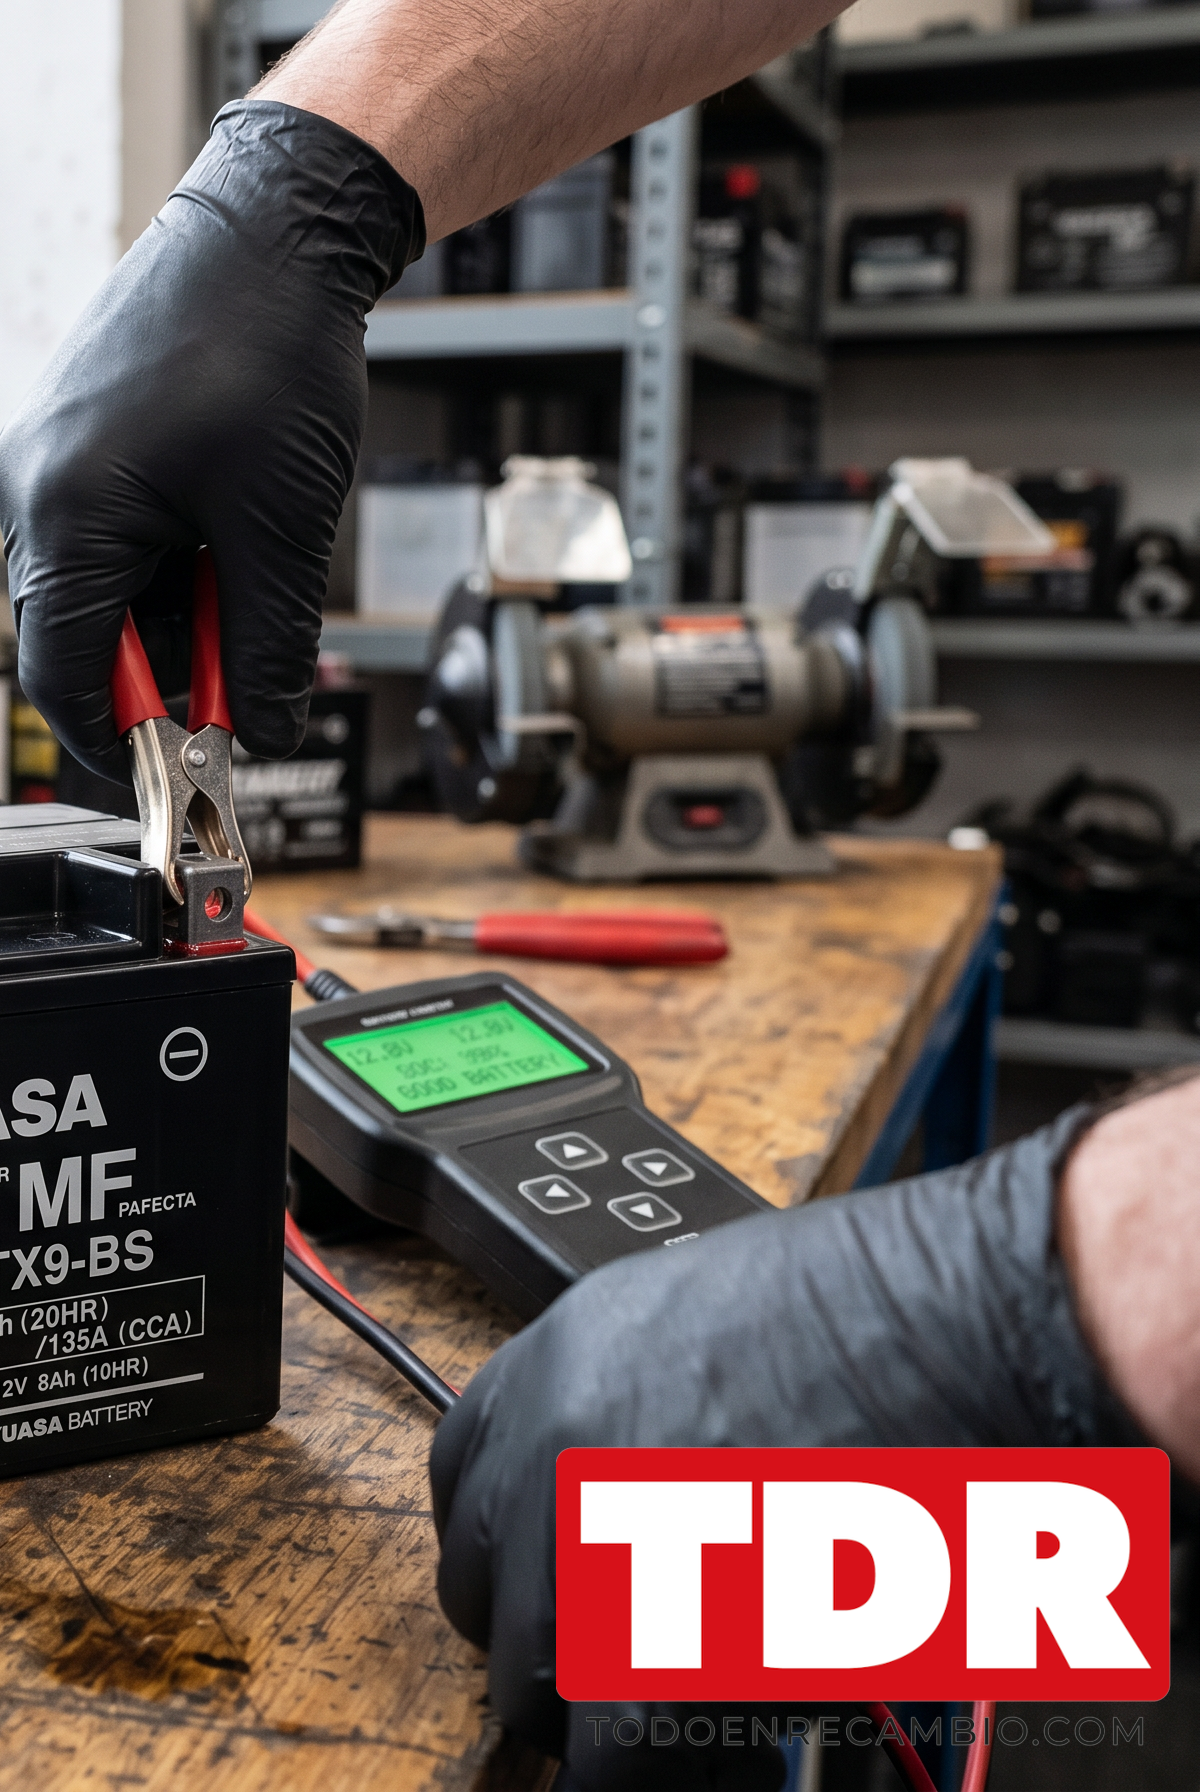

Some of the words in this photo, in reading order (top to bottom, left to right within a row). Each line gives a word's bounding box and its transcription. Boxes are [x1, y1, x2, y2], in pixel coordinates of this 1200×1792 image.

[462, 1053, 562, 1086] BATTERY
[19, 1147, 137, 1232] MF
[118, 1191, 197, 1219] PAFECTA
[20, 1297, 110, 1335] (20HR)
[35, 1326, 109, 1360] /135A
[118, 1310, 192, 1346] (CCA)
[37, 1369, 76, 1392] 8Ah
[83, 1356, 149, 1387] (10HR)
[68, 1398, 154, 1431] BATTERY
